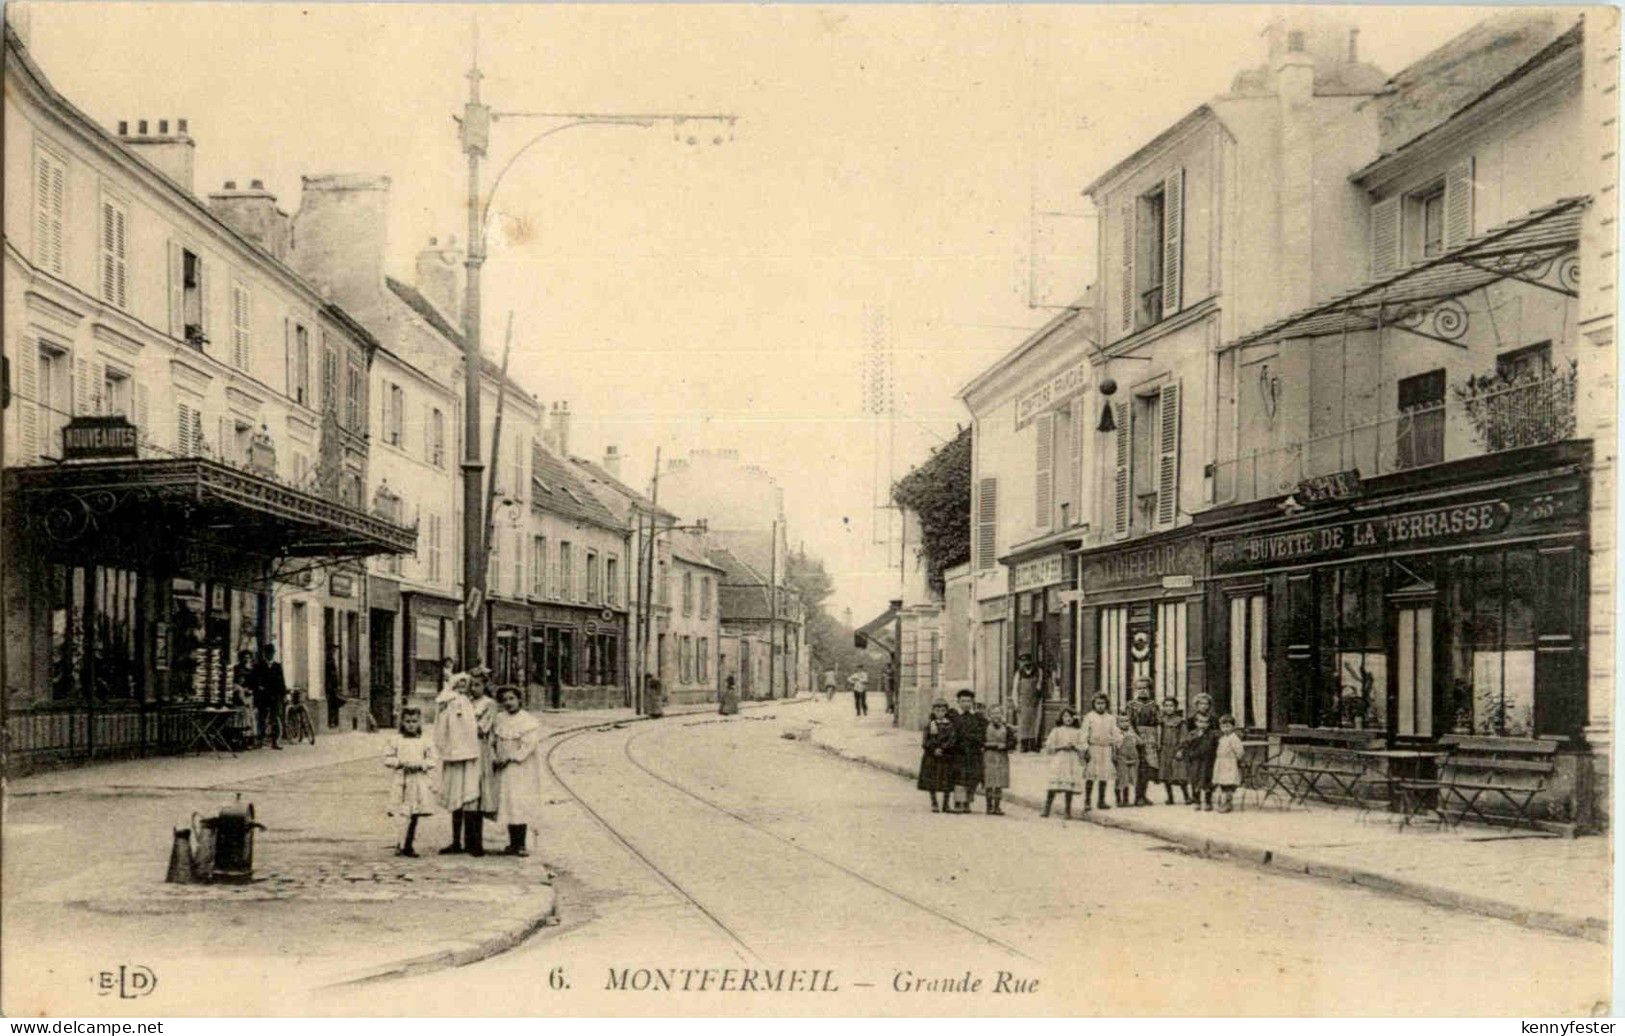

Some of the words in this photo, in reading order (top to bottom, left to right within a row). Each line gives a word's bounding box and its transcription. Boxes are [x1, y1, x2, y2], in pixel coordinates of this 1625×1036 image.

[1249, 531, 1314, 561] BUVETTE
[1321, 527, 1345, 551] DE
[1353, 522, 1378, 547] LA
[1384, 504, 1495, 542] TERRASSE
